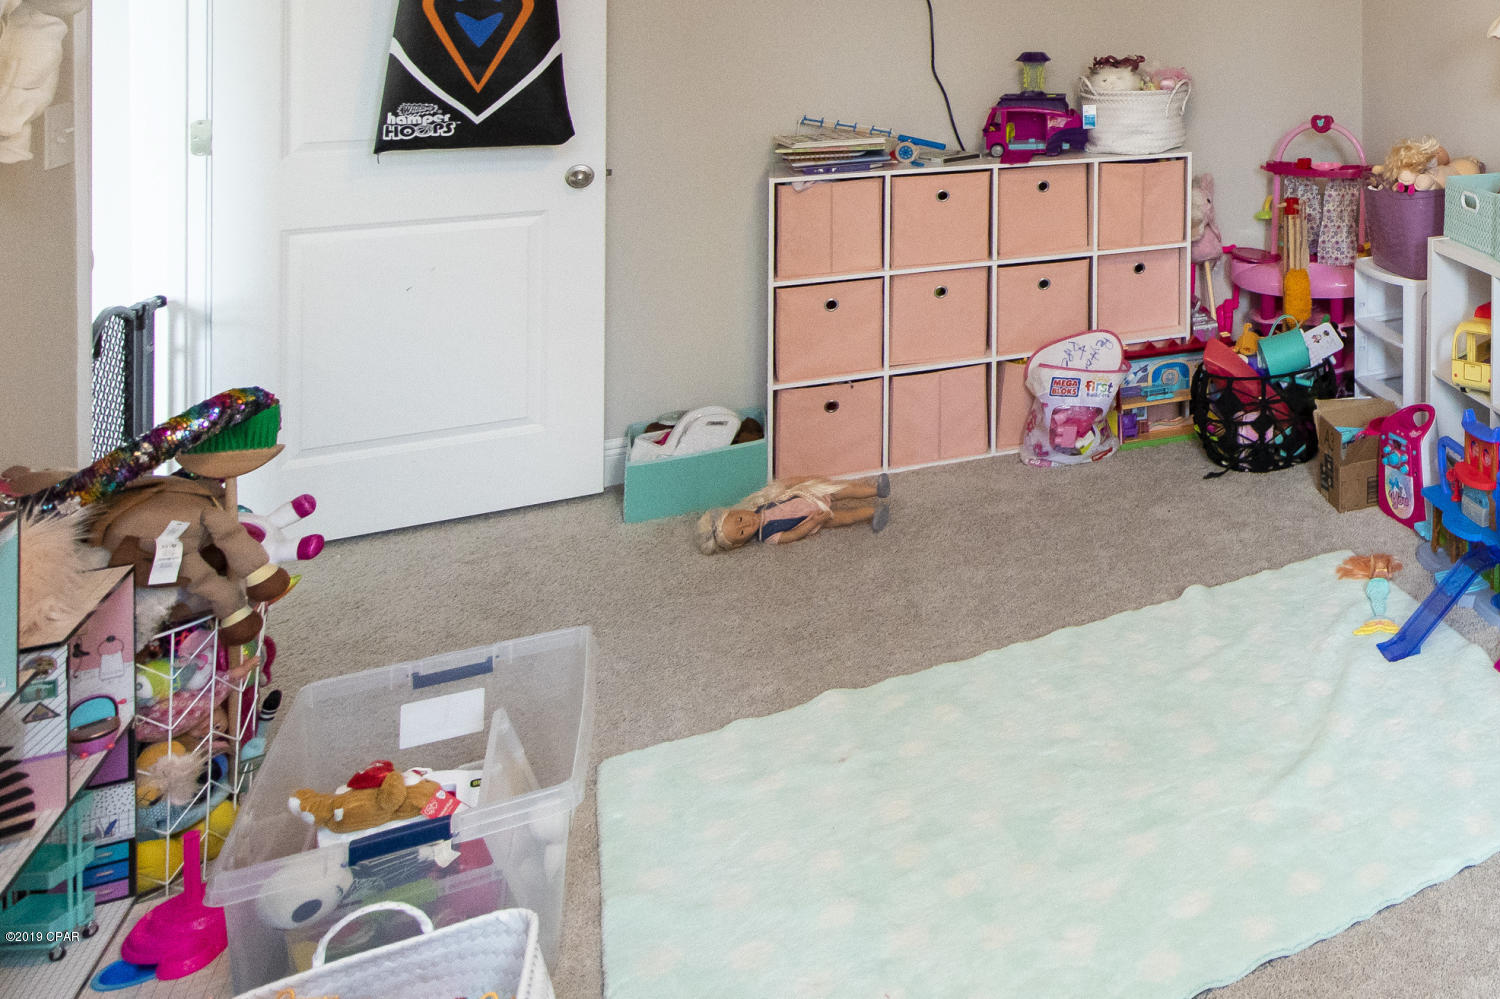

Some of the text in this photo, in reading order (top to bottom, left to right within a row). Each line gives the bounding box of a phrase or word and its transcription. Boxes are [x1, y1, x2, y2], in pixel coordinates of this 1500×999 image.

[386, 112, 451, 126] hamper
[383, 121, 456, 140] HOOPS
[1053, 379, 1078, 387] MEGA
[1085, 380, 1113, 394] first
[1051, 387, 1077, 395] BLOKS
